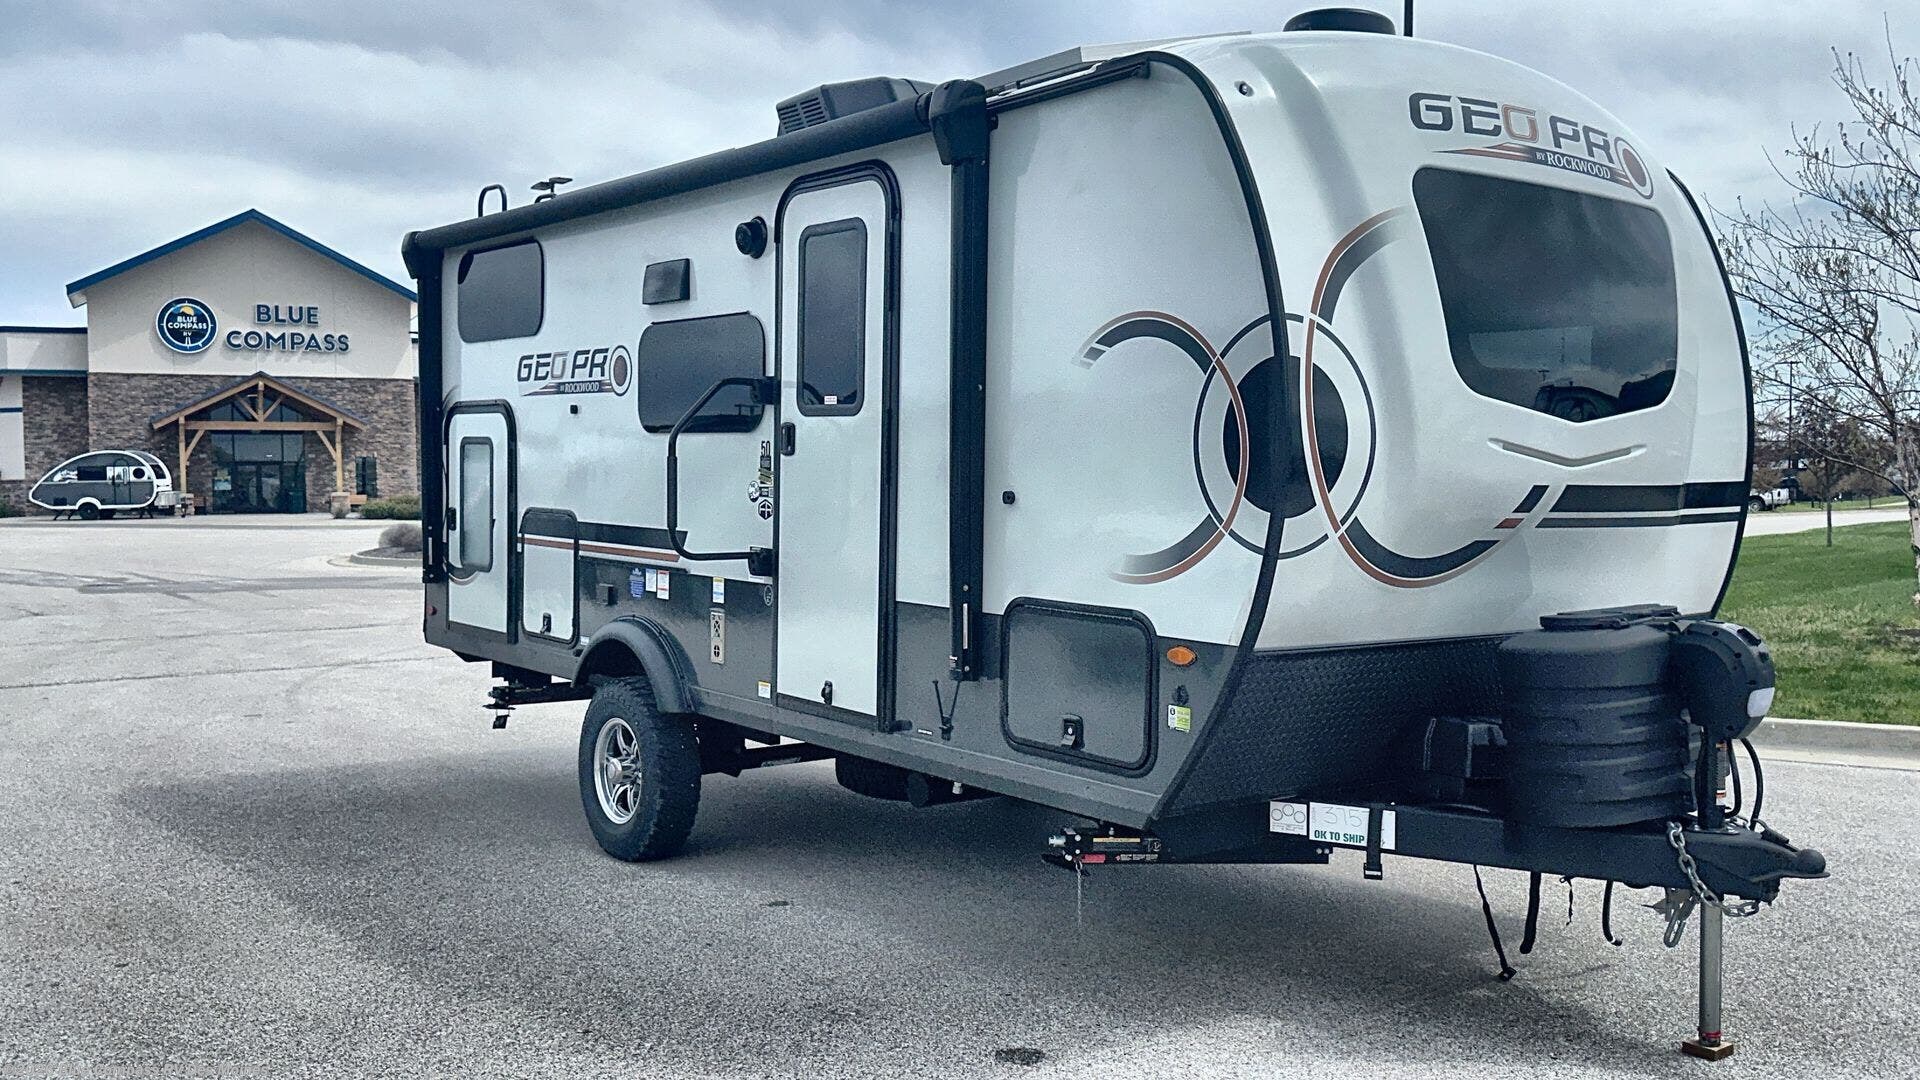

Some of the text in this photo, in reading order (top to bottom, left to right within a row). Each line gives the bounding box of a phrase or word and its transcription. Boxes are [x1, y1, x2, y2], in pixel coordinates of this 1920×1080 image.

[1408, 92, 1654, 200] GEO PRO
[1535, 151, 1611, 179] BY ROCKWOOD
[256, 304, 319, 325] BLUE
[167, 322, 208, 330] COMPASS
[226, 330, 350, 352] COMPASS
[517, 345, 632, 397] GEO PRO
[564, 382, 600, 394] ROCKWOOD
[1314, 829, 1365, 844] OK TO SHIP
